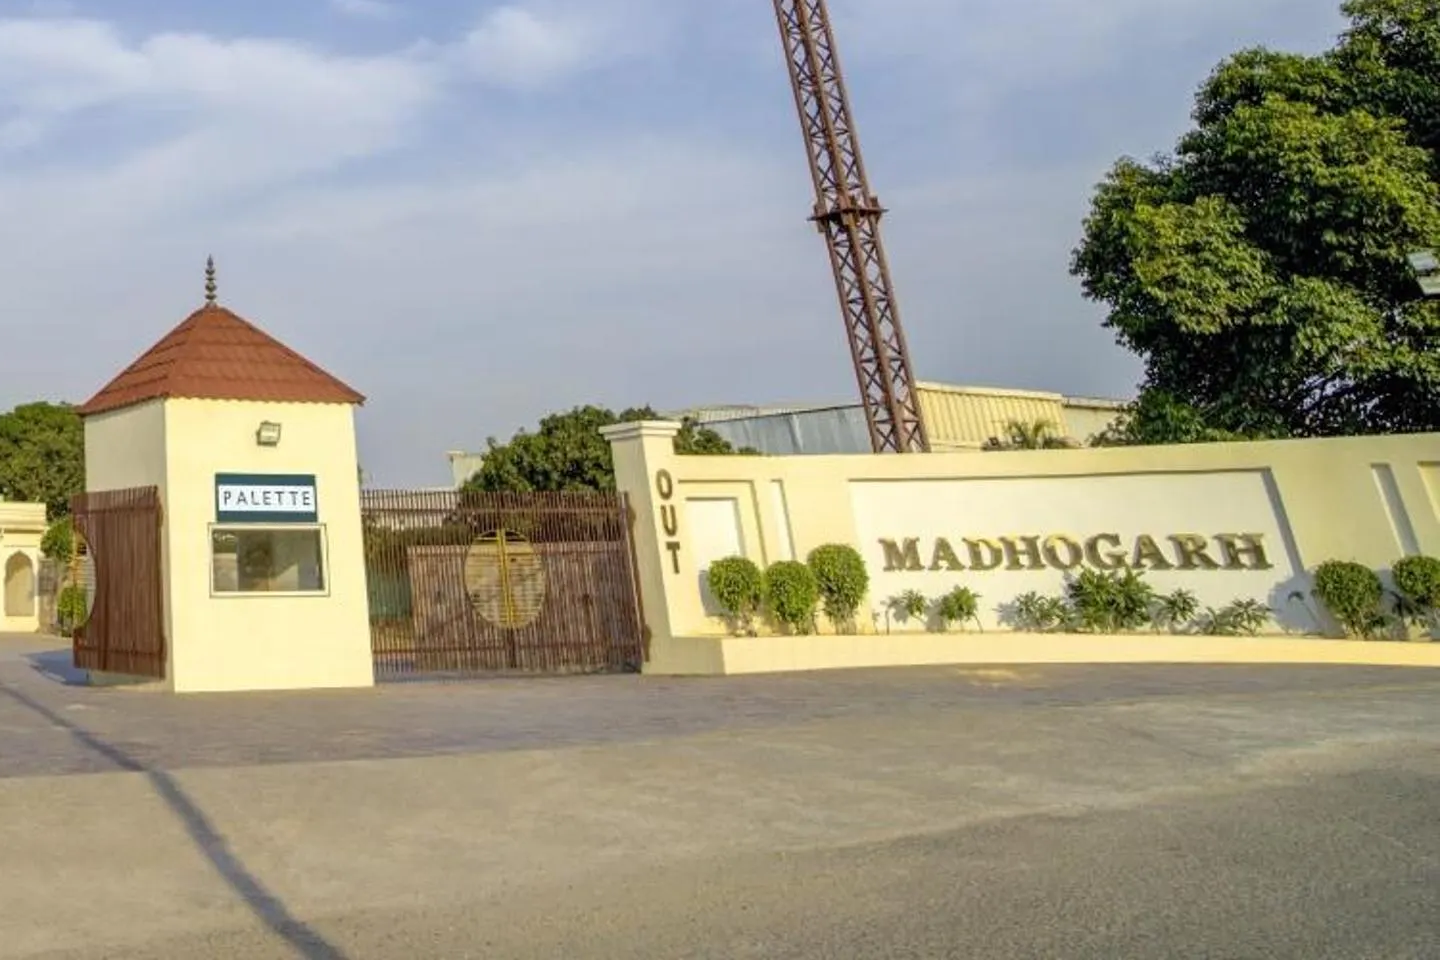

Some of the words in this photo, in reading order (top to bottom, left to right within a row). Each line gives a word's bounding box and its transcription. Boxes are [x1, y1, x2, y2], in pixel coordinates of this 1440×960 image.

[223, 491, 311, 506] PALETTE
[656, 469, 680, 575] OUT
[877, 532, 1274, 573] MADHOGARH
